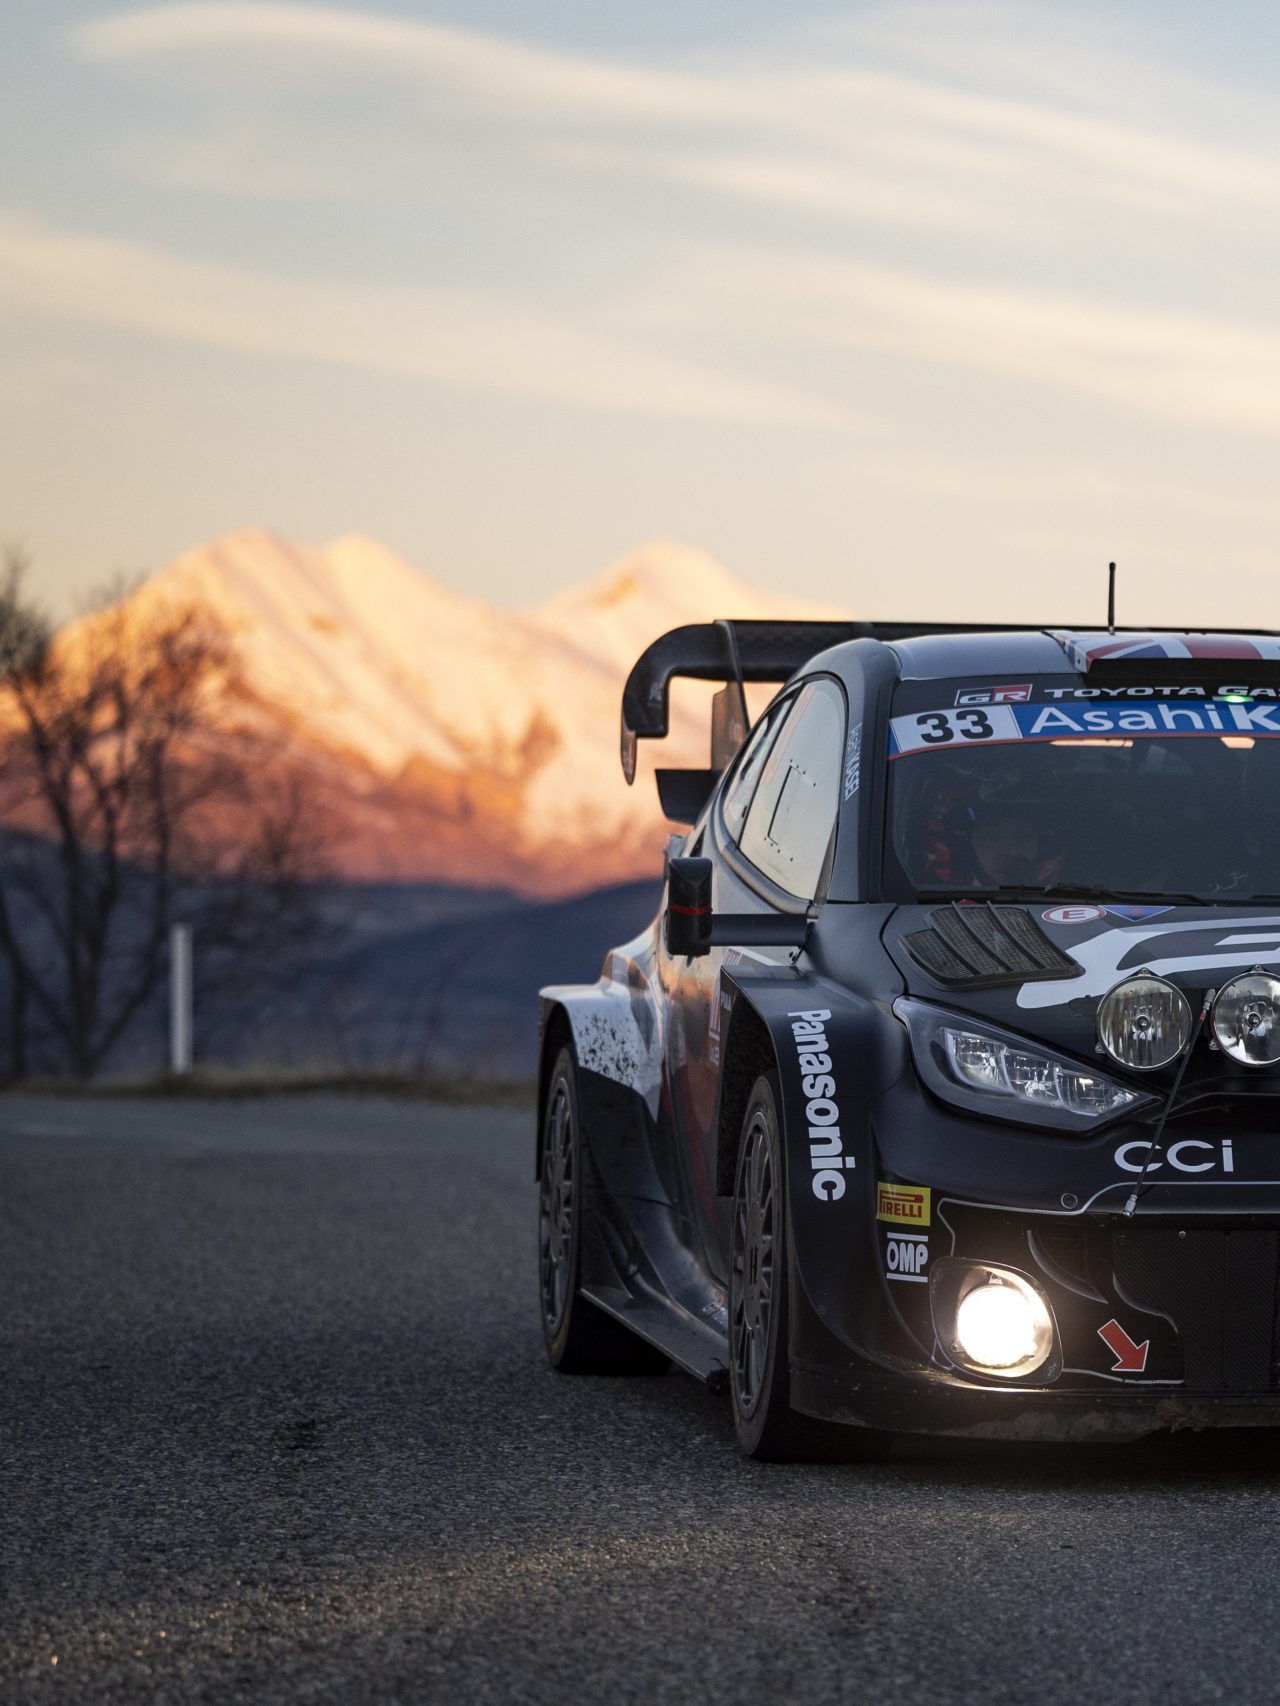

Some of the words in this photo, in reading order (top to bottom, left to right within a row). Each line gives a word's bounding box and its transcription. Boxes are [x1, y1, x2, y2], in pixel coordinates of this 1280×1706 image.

[960, 690, 1027, 704] GR
[1044, 686, 1206, 699] TOYOTA
[916, 709, 994, 744] 33
[787, 1009, 856, 1201] Panasonic
[879, 1190, 925, 1219] PIRELLI
[886, 1240, 929, 1274] OMP
